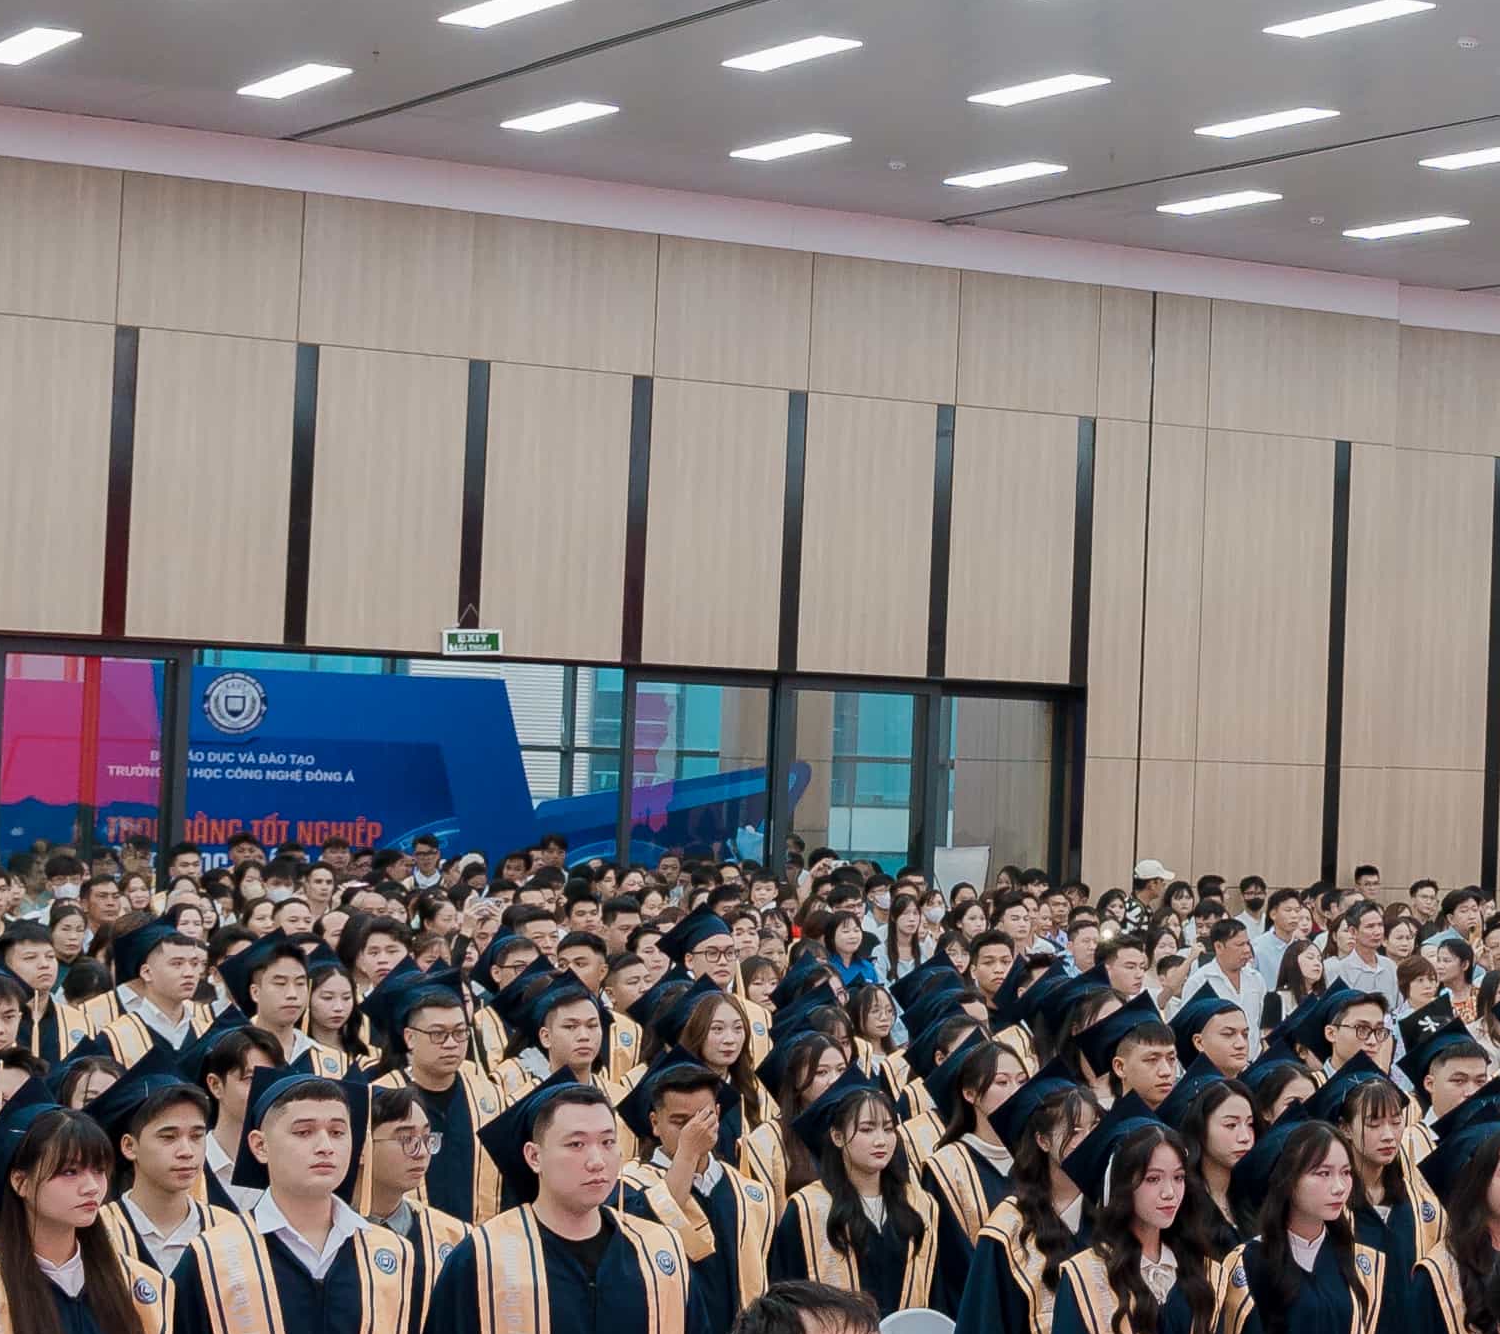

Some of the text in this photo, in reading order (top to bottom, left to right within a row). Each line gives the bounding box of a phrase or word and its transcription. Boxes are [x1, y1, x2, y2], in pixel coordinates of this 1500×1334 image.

[457, 634, 488, 643] EXIT
[193, 768, 222, 782] HỌC
[225, 766, 262, 780] CÔNG
[266, 767, 301, 783] NGHỆ
[305, 768, 342, 783] ĐÔNG
[345, 768, 355, 783] Á
[251, 812, 290, 846] TỐT
